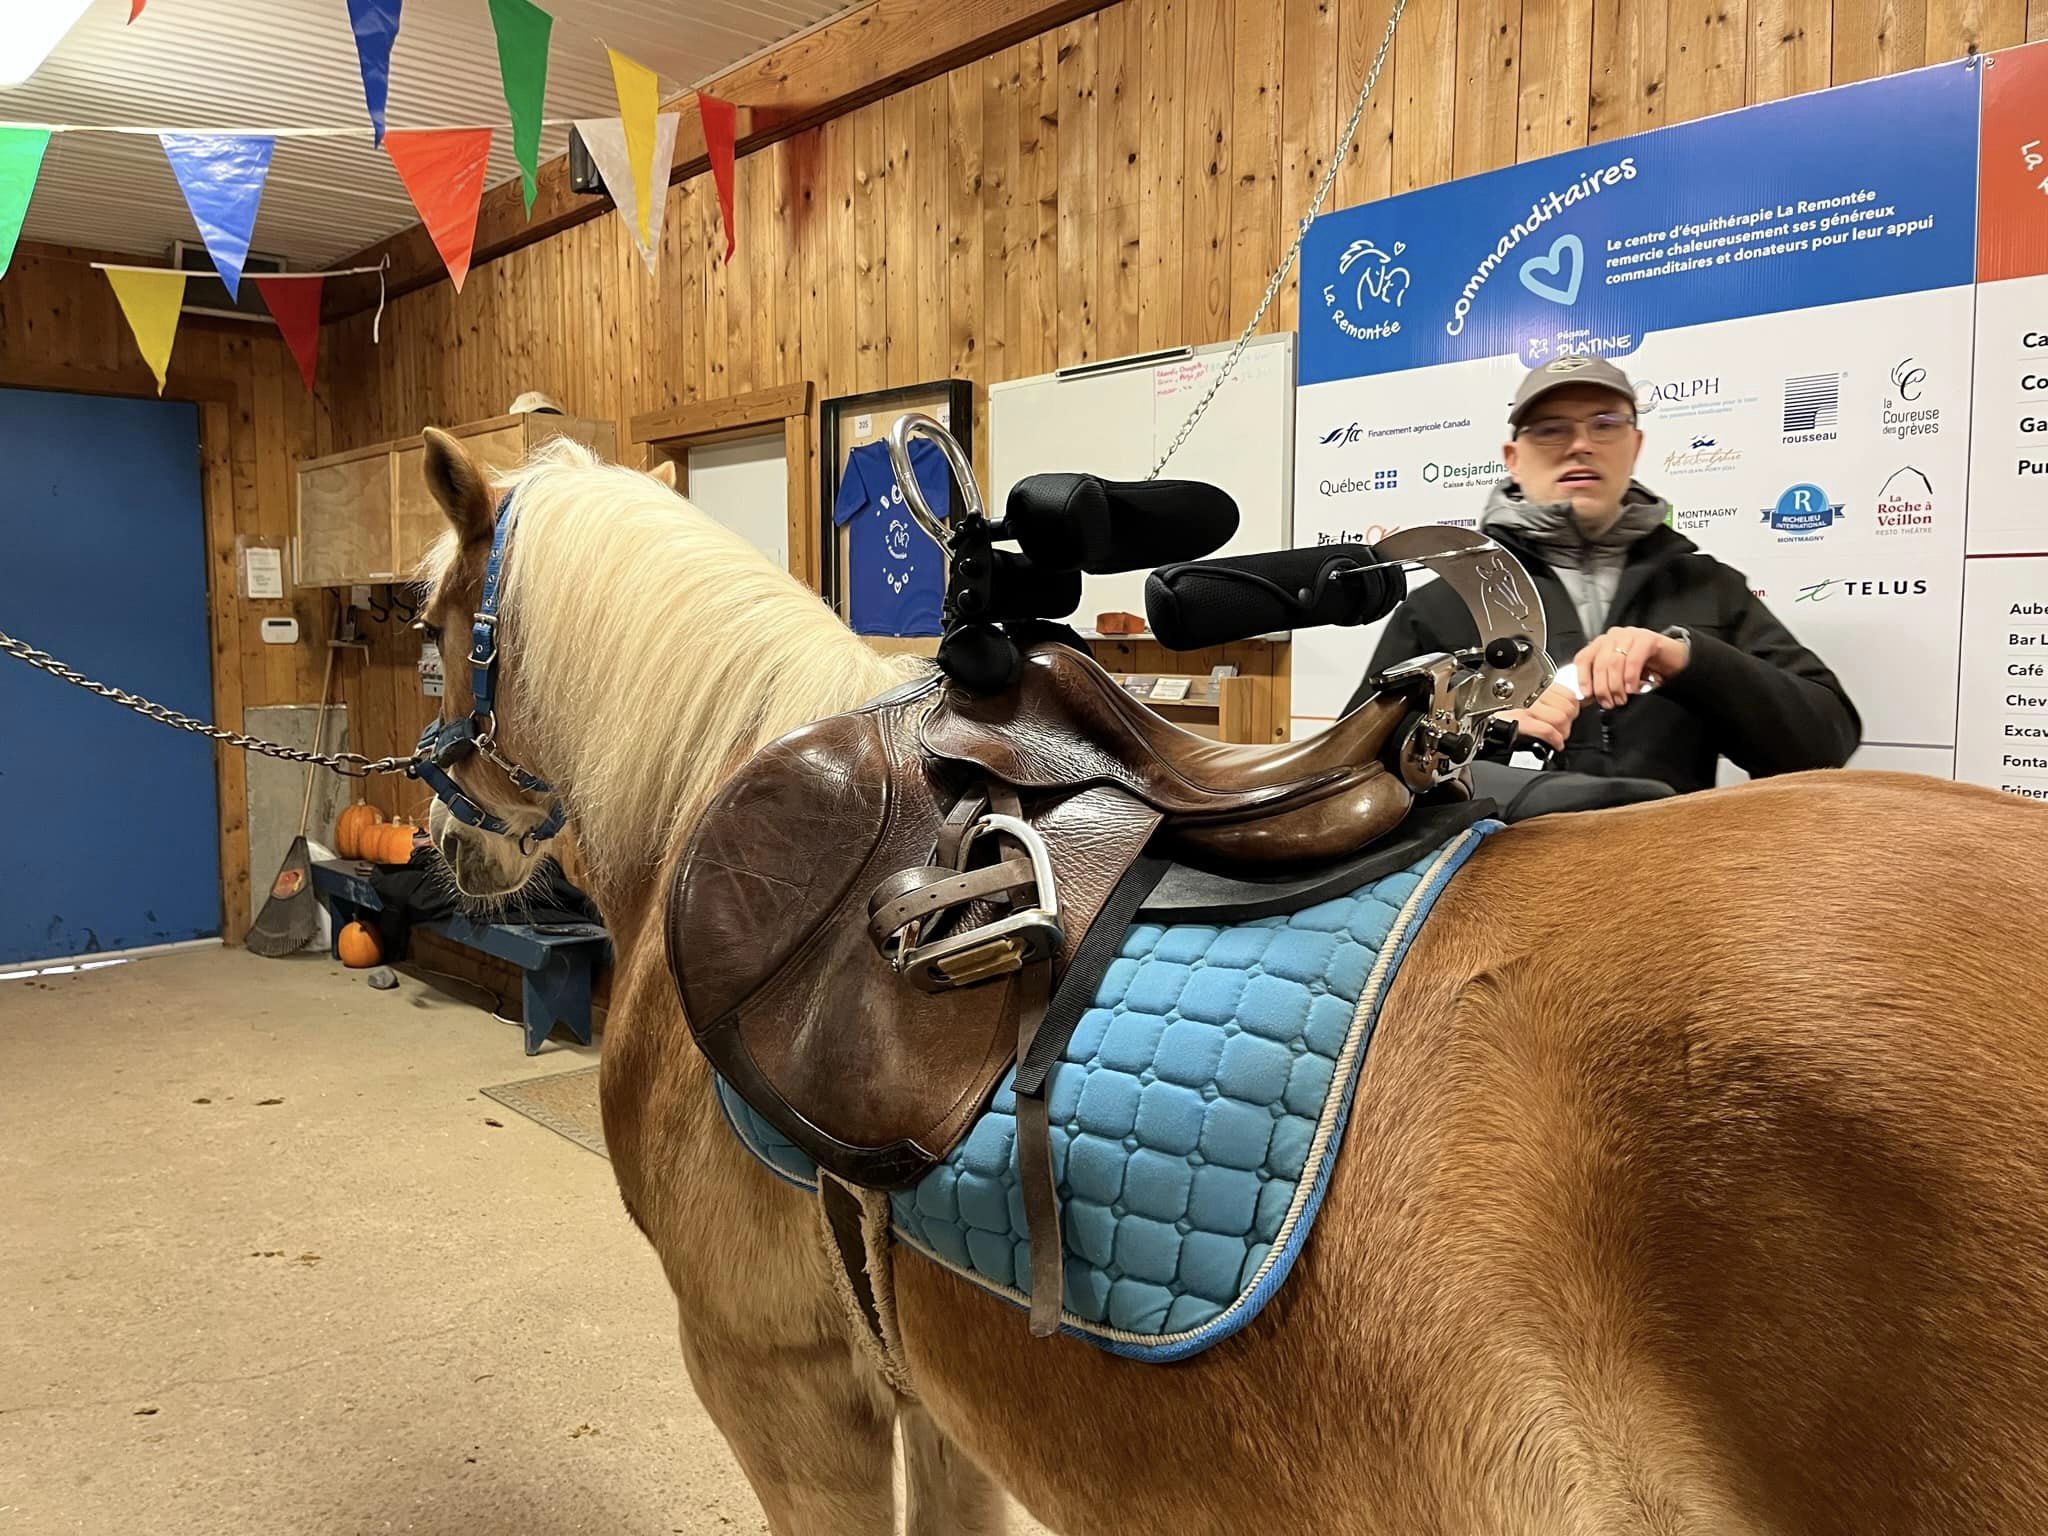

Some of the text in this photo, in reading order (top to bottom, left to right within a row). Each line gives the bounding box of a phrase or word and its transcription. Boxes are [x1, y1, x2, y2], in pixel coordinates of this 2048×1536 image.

[2020, 140, 2044, 171] La
[1606, 239, 1622, 252] Le
[1624, 230, 1666, 249] centre
[1776, 204, 1794, 218] La
[1797, 188, 1876, 214] Remontée
[1605, 204, 1896, 269] remercie chaleureusement ses généreux
[1446, 157, 1638, 336] commanditaires
[1605, 214, 1935, 286] commanditaires et donateurs pour leur appui
[1322, 284, 1336, 307] La
[1331, 309, 1401, 340] Remontée
[1555, 334, 1632, 357] PLATINE
[1649, 377, 1719, 402] AQLPH
[1883, 397, 1893, 409] la
[1882, 408, 1940, 425] Coureuse
[1367, 419, 1471, 438] Financement agricole Canada
[1897, 421, 1940, 441] grèves
[2019, 417, 2048, 433] Ga
[1782, 432, 1837, 445] rousseau
[1443, 461, 1509, 478] Desjardins
[1319, 478, 1372, 497] Québec
[1443, 481, 1465, 489] Caisse
[1465, 479, 1475, 488] du
[1475, 477, 1494, 486] Nord
[1877, 500, 1933, 514] Roche à
[1889, 495, 1902, 503] La
[1677, 507, 1738, 520] MONTMAGNY
[1781, 514, 1822, 523] RICHELIEU
[1877, 513, 1933, 527] Veillon
[1776, 535, 1825, 544] MONTMAGNY
[1844, 580, 1927, 596] TELUS
[2009, 633, 2036, 646] Bar
[2007, 663, 2045, 677] Café
[2003, 754, 2048, 769] Fonta
